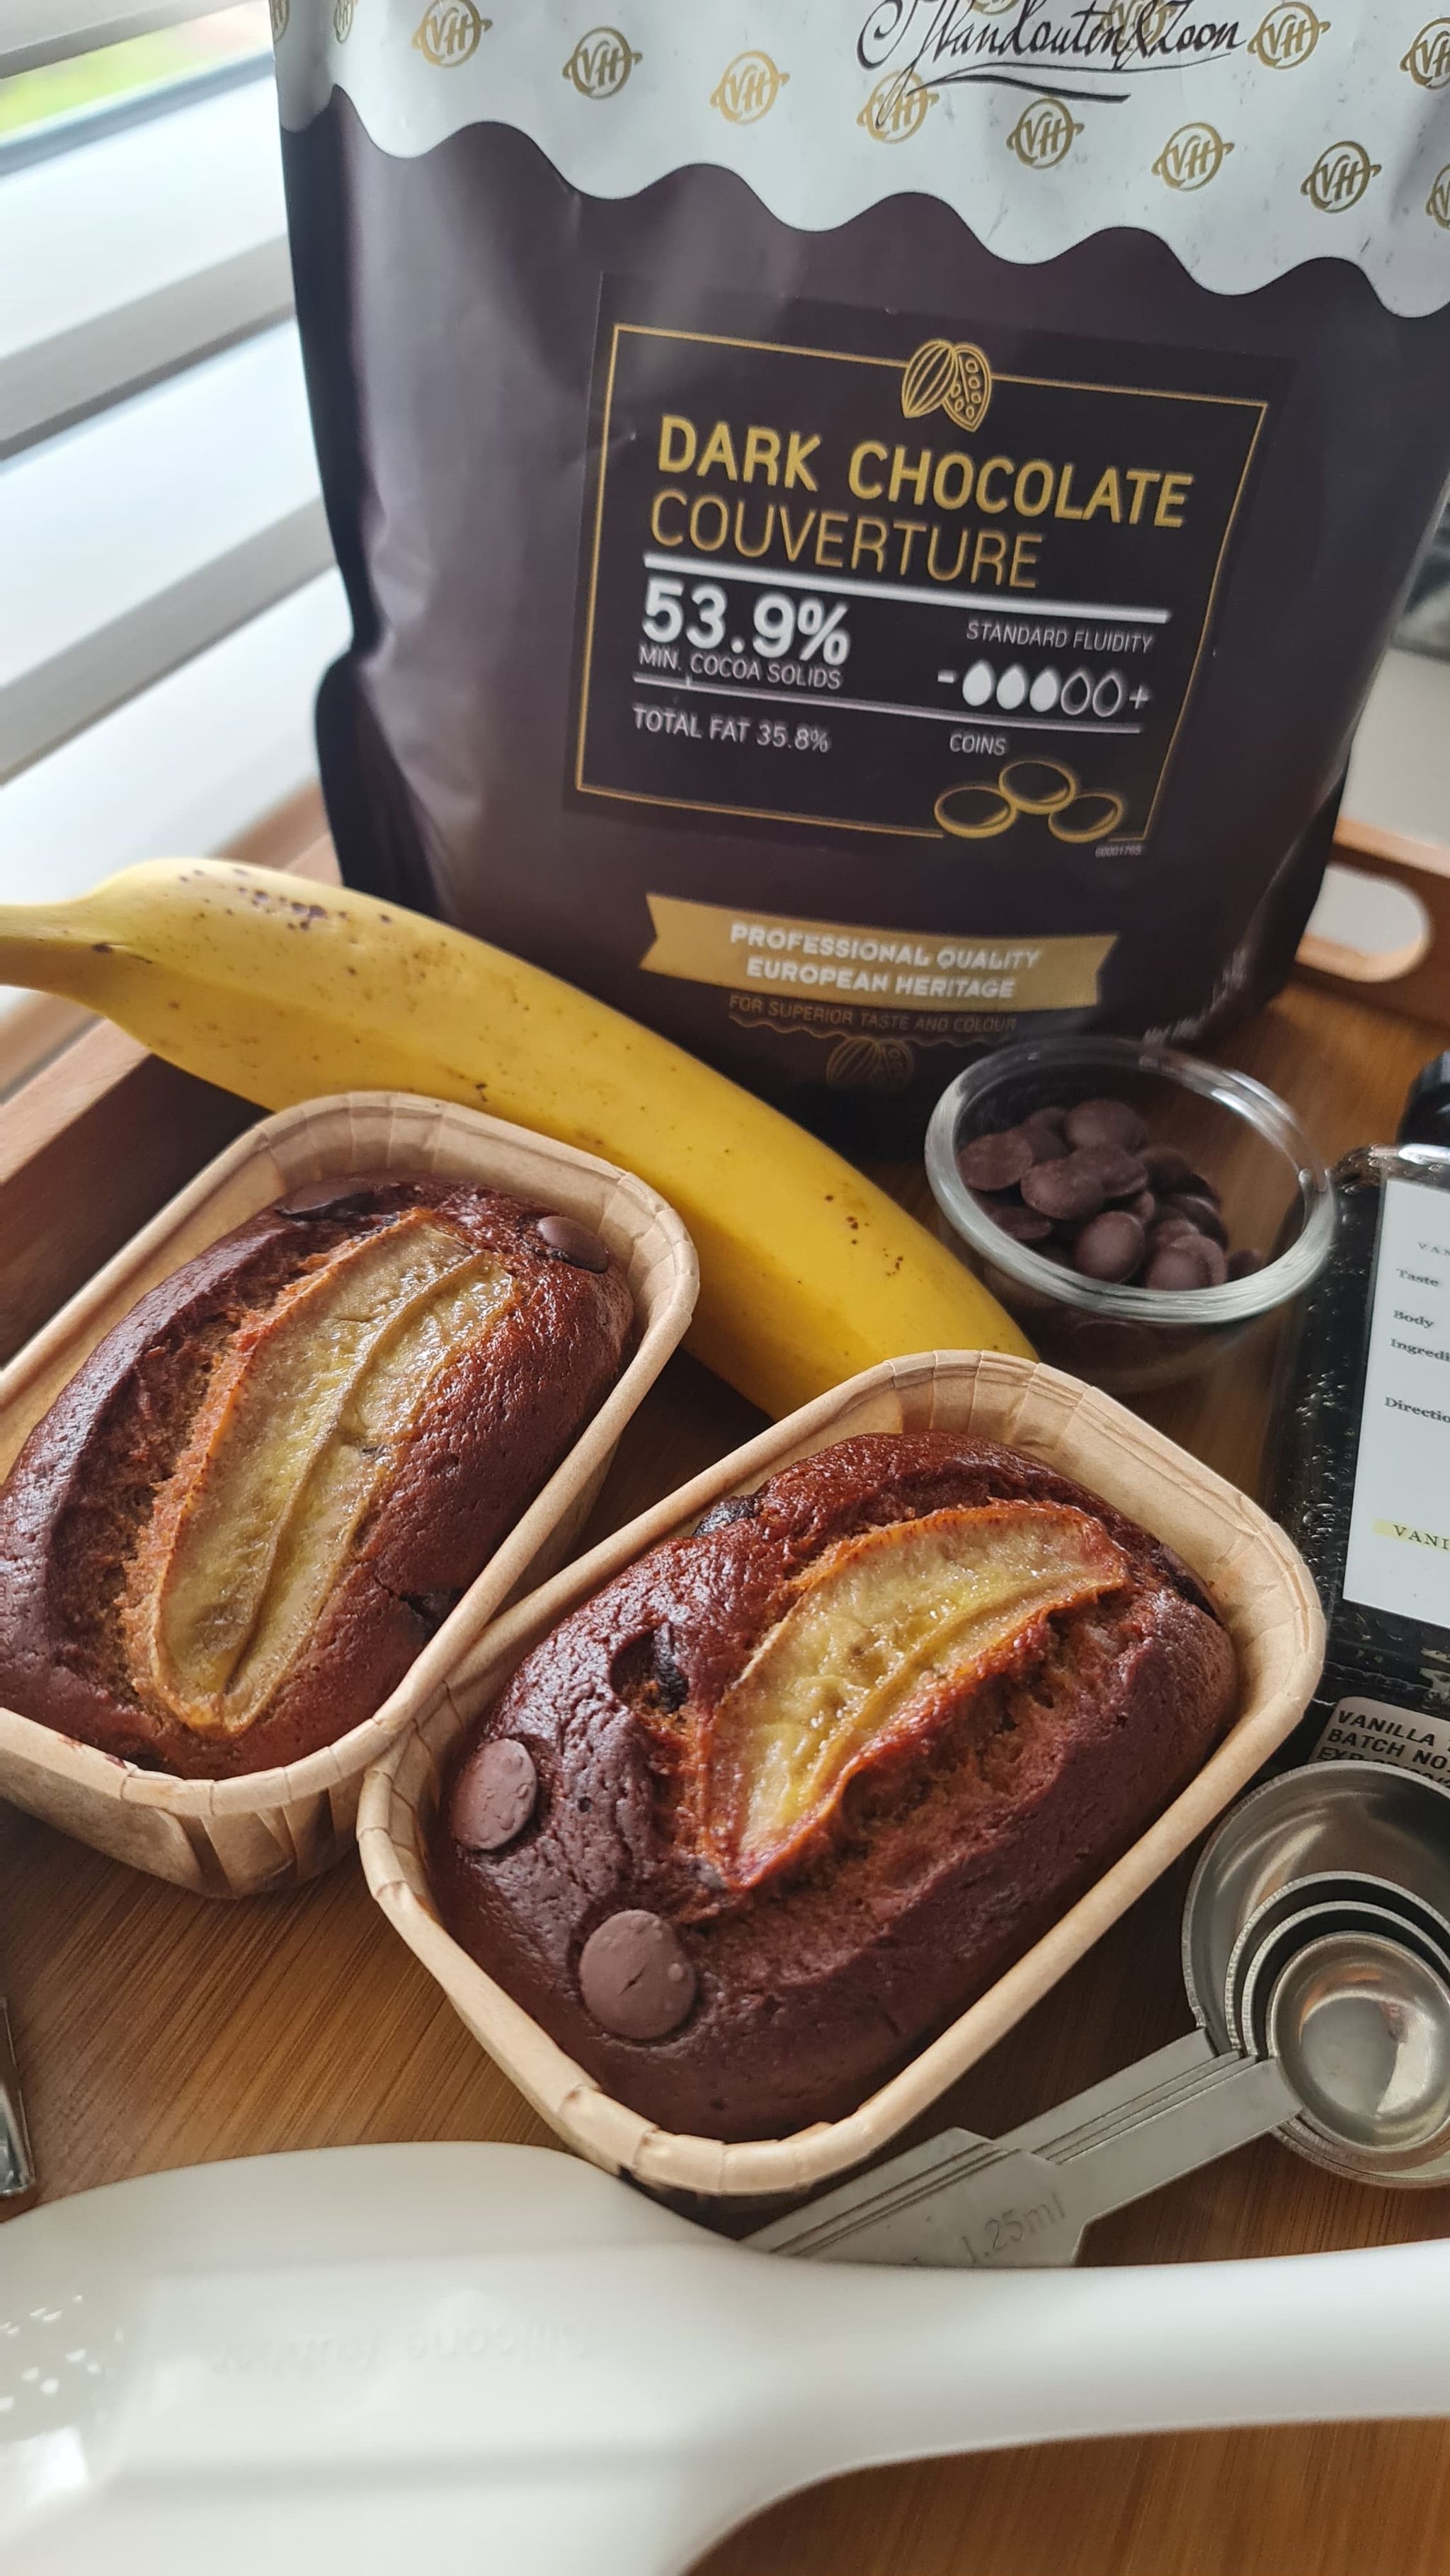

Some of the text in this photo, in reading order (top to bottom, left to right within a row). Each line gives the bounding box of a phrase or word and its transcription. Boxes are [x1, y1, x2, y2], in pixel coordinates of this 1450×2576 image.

[657, 414, 1194, 528] DARK CHOCOLATE
[649, 488, 1045, 589] COUVERTURE
[642, 575, 850, 666] 53.9%
[966, 618, 1157, 654] STANDARD FLUIDITY
[639, 642, 842, 690] MIN. COCOA SOLIDS
[634, 702, 831, 753] TOTAL FAT 35.8%
[949, 731, 1007, 756] COINS
[730, 921, 1043, 971] PROFESSIONAL QUALITY
[746, 956, 1016, 998] EUROPEAN HERITAGE
[729, 993, 1018, 1035] FOR SUPERIOR TASTE AND COLOUR
[1395, 1267, 1439, 1287] Taste
[1393, 1309, 1434, 1329] Body
[1393, 1523, 1449, 1551] VANI
[1326, 1728, 1405, 1757] BATCH
[1337, 1709, 1435, 1747] VANILLA
[961, 2190, 1065, 2263] 1.25ml
